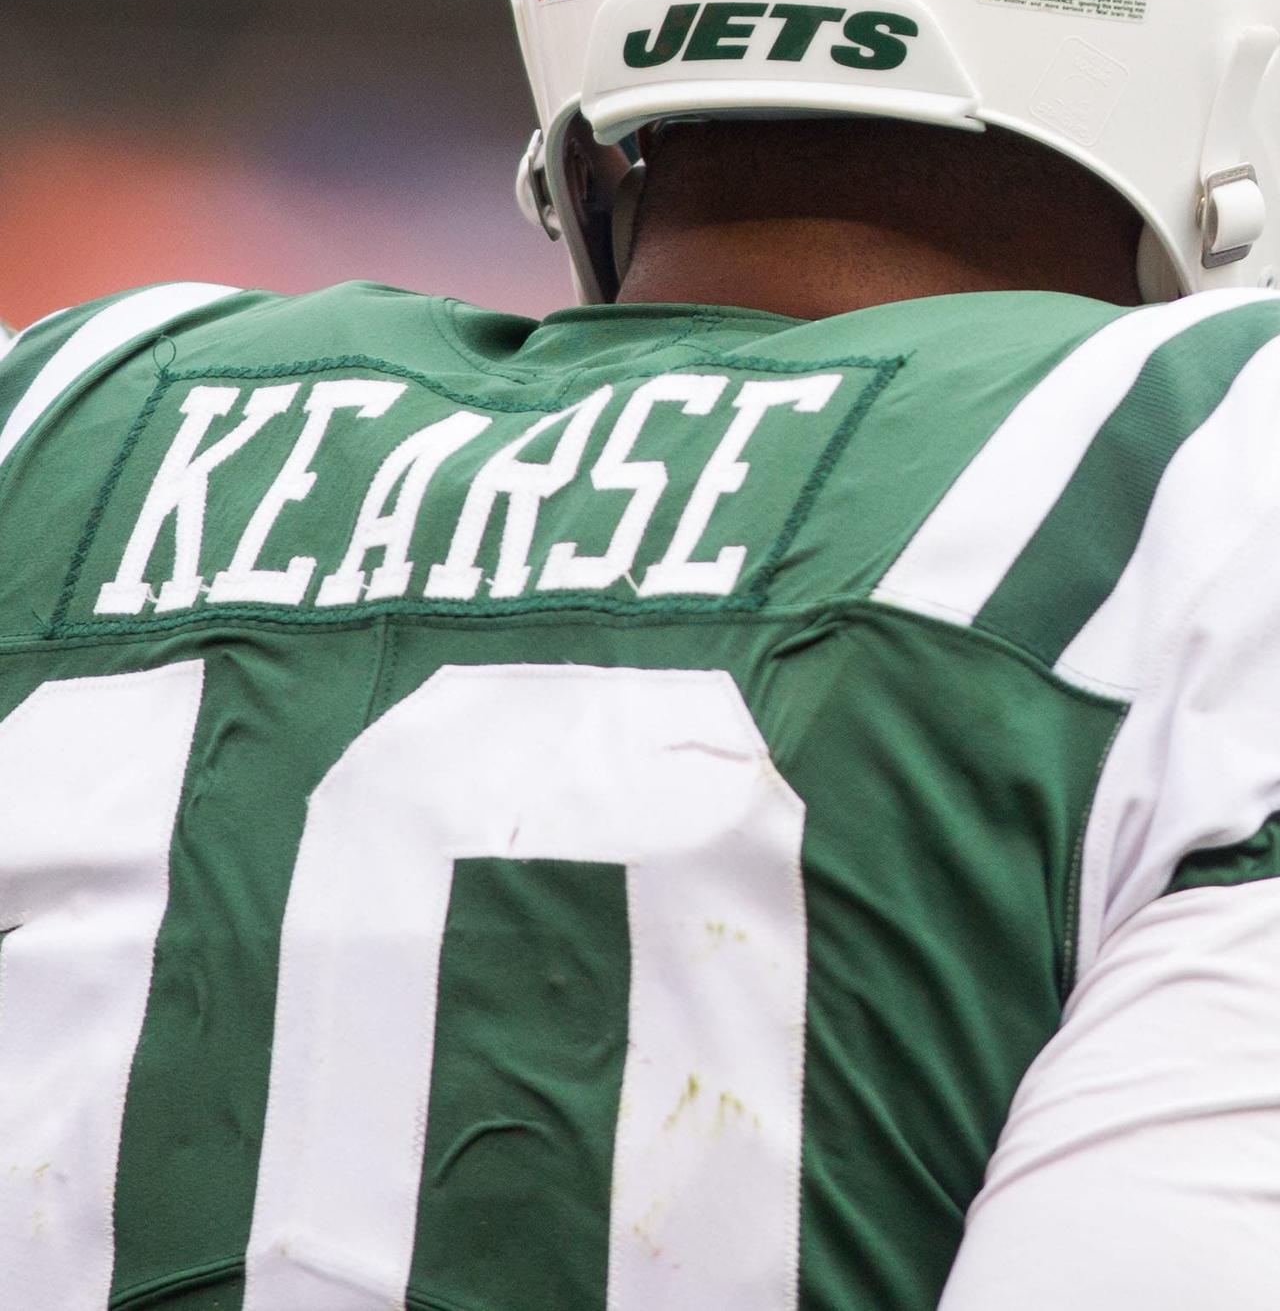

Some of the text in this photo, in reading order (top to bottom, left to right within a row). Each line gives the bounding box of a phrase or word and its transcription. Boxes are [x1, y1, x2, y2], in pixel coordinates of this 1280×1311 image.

[623, 2, 919, 70] JETS
[94, 375, 843, 615] KEARSE
[0, 658, 807, 1311] 10
